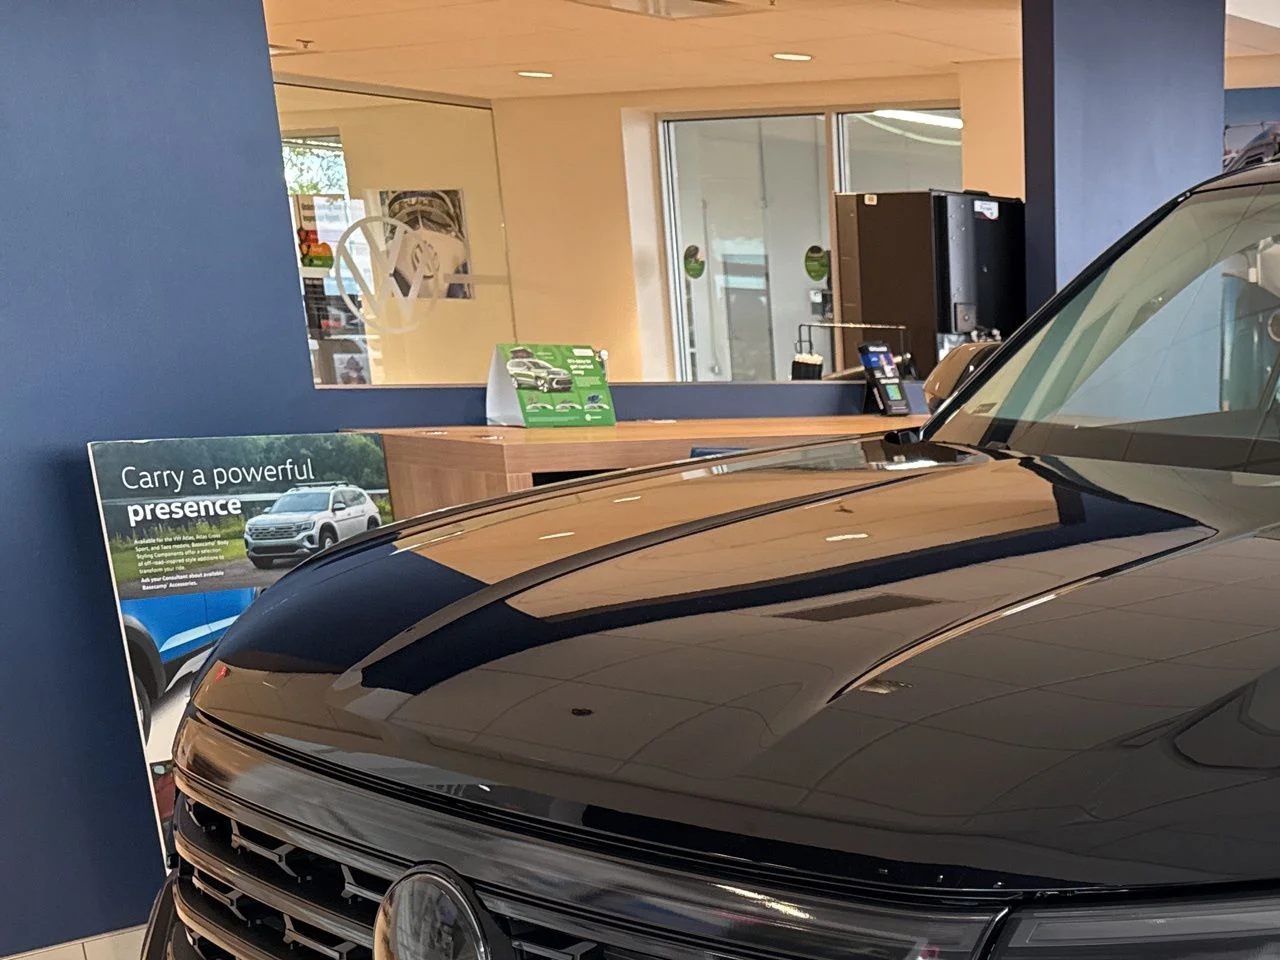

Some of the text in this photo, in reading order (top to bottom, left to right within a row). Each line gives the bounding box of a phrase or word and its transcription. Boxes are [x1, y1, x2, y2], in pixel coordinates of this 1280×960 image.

[121, 458, 315, 492] Carry a powerful
[127, 498, 242, 527] presence
